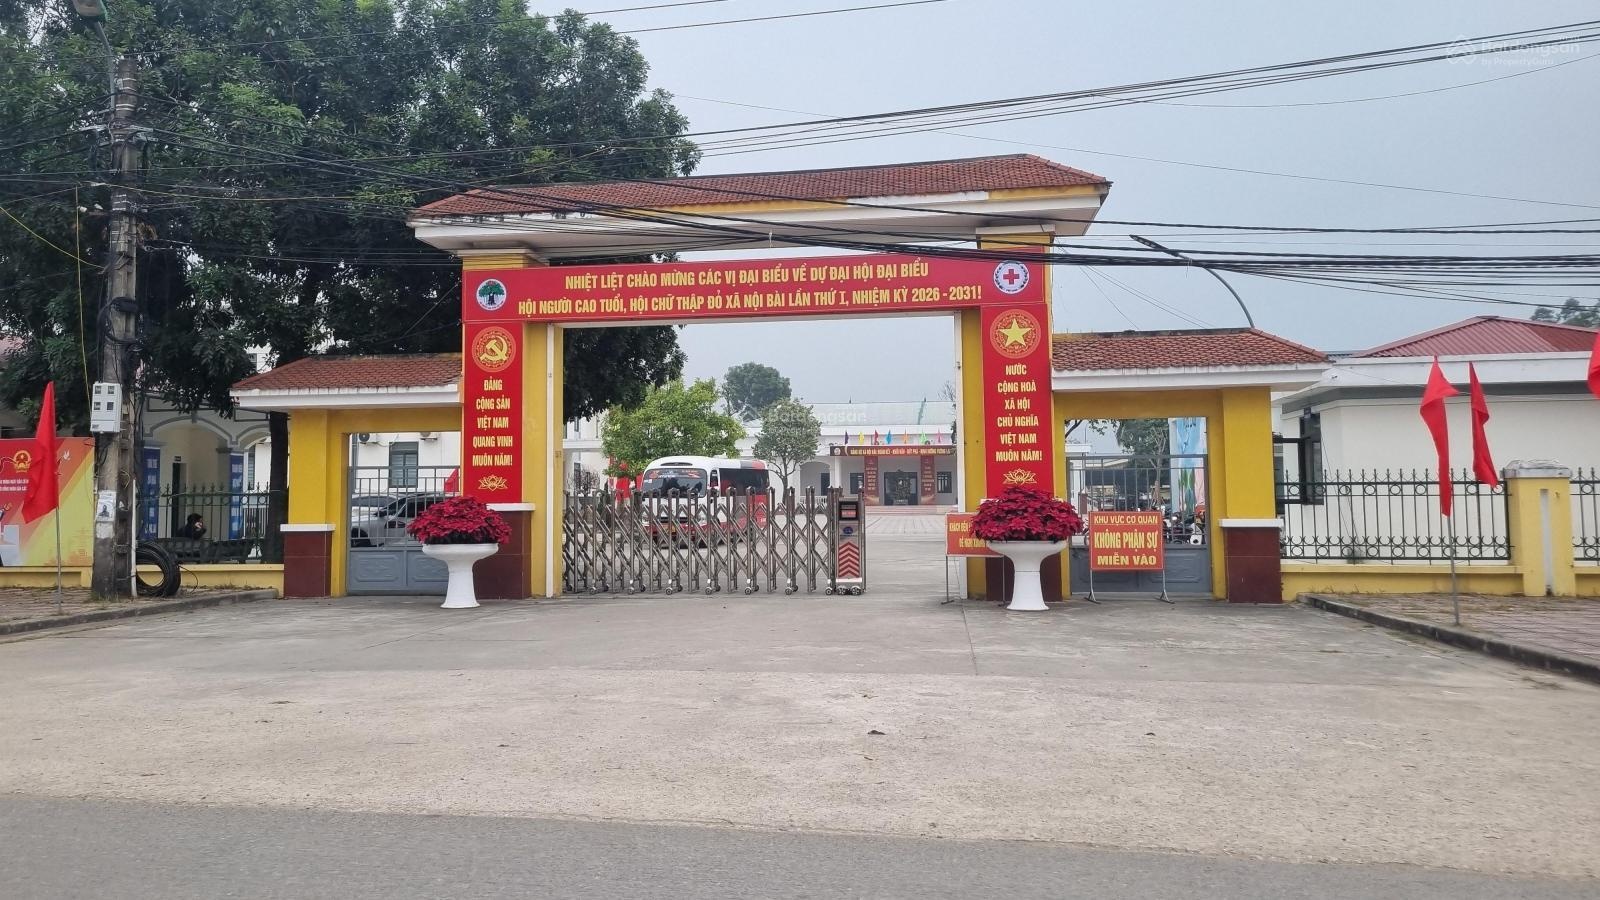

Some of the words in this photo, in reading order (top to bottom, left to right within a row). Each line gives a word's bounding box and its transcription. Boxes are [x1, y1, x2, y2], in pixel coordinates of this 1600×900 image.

[565, 272, 598, 292] NHIỆT
[601, 271, 624, 291] LIỆT
[626, 270, 658, 288] CHÀO
[660, 269, 696, 287] MỪNG
[698, 268, 722, 286] CÁC
[724, 270, 736, 287] VỊ
[738, 269, 759, 286] ĐẠI
[762, 263, 789, 283] BIỂU
[792, 262, 807, 282] VỀ
[810, 265, 828, 284] DỰ
[829, 265, 850, 283] ĐẠI
[853, 262, 874, 282] HỘI
[877, 263, 897, 281] ĐẠI
[901, 257, 929, 278] BIỂU
[518, 298, 537, 318] HỘI
[539, 296, 572, 314] NGƯỜI
[575, 299, 597, 314] CAO
[599, 293, 627, 314] TUỔI,
[629, 294, 649, 315] HỘI
[651, 293, 675, 312] CHỮ
[677, 293, 704, 313] THẬP
[707, 290, 723, 310] ĐỎ
[726, 292, 741, 309] XÃ
[743, 291, 764, 311] NỘI
[766, 290, 785, 308] BÀI
[788, 287, 811, 307] LẦN
[813, 287, 837, 306] THỨ
[838, 290, 849, 307] I,
[852, 286, 890, 307] NHIỆM
[893, 285, 909, 303] KỲ
[911, 287, 940, 303] 2026
[949, 284, 982, 301] 2031!
[1005, 363, 1027, 375] NƯỚC
[483, 375, 503, 391] ĐẢNG
[997, 380, 1019, 395] CỘNG
[476, 396, 495, 412] CỘNG
[496, 394, 511, 410] SẢN
[1004, 398, 1016, 410] XÃ
[1017, 398, 1031, 412] HỘI
[477, 415, 492, 431] VIỆT
[493, 416, 509, 429] NAM
[997, 413, 1013, 427] CHỦ
[1014, 414, 1039, 427] NGHĨA
[472, 435, 496, 448] QUANG
[497, 435, 513, 447] VINH
[1000, 431, 1017, 446] VIỆT
[1018, 433, 1037, 444] NAM
[472, 453, 493, 467] MUÔN
[494, 452, 513, 466] NĂM!
[995, 450, 1020, 462] MUÔN
[1021, 448, 1043, 461] NĂM!
[1094, 515, 1109, 524] KHU
[1110, 515, 1125, 526] VỰC
[1137, 515, 1158, 525] QUAN
[1094, 528, 1122, 549] KHÔNG
[1122, 528, 1145, 553] PHẬN
[1146, 529, 1159, 553] SỰ
[1097, 551, 1130, 566] MIỄN
[1132, 553, 1157, 566] VÀO
